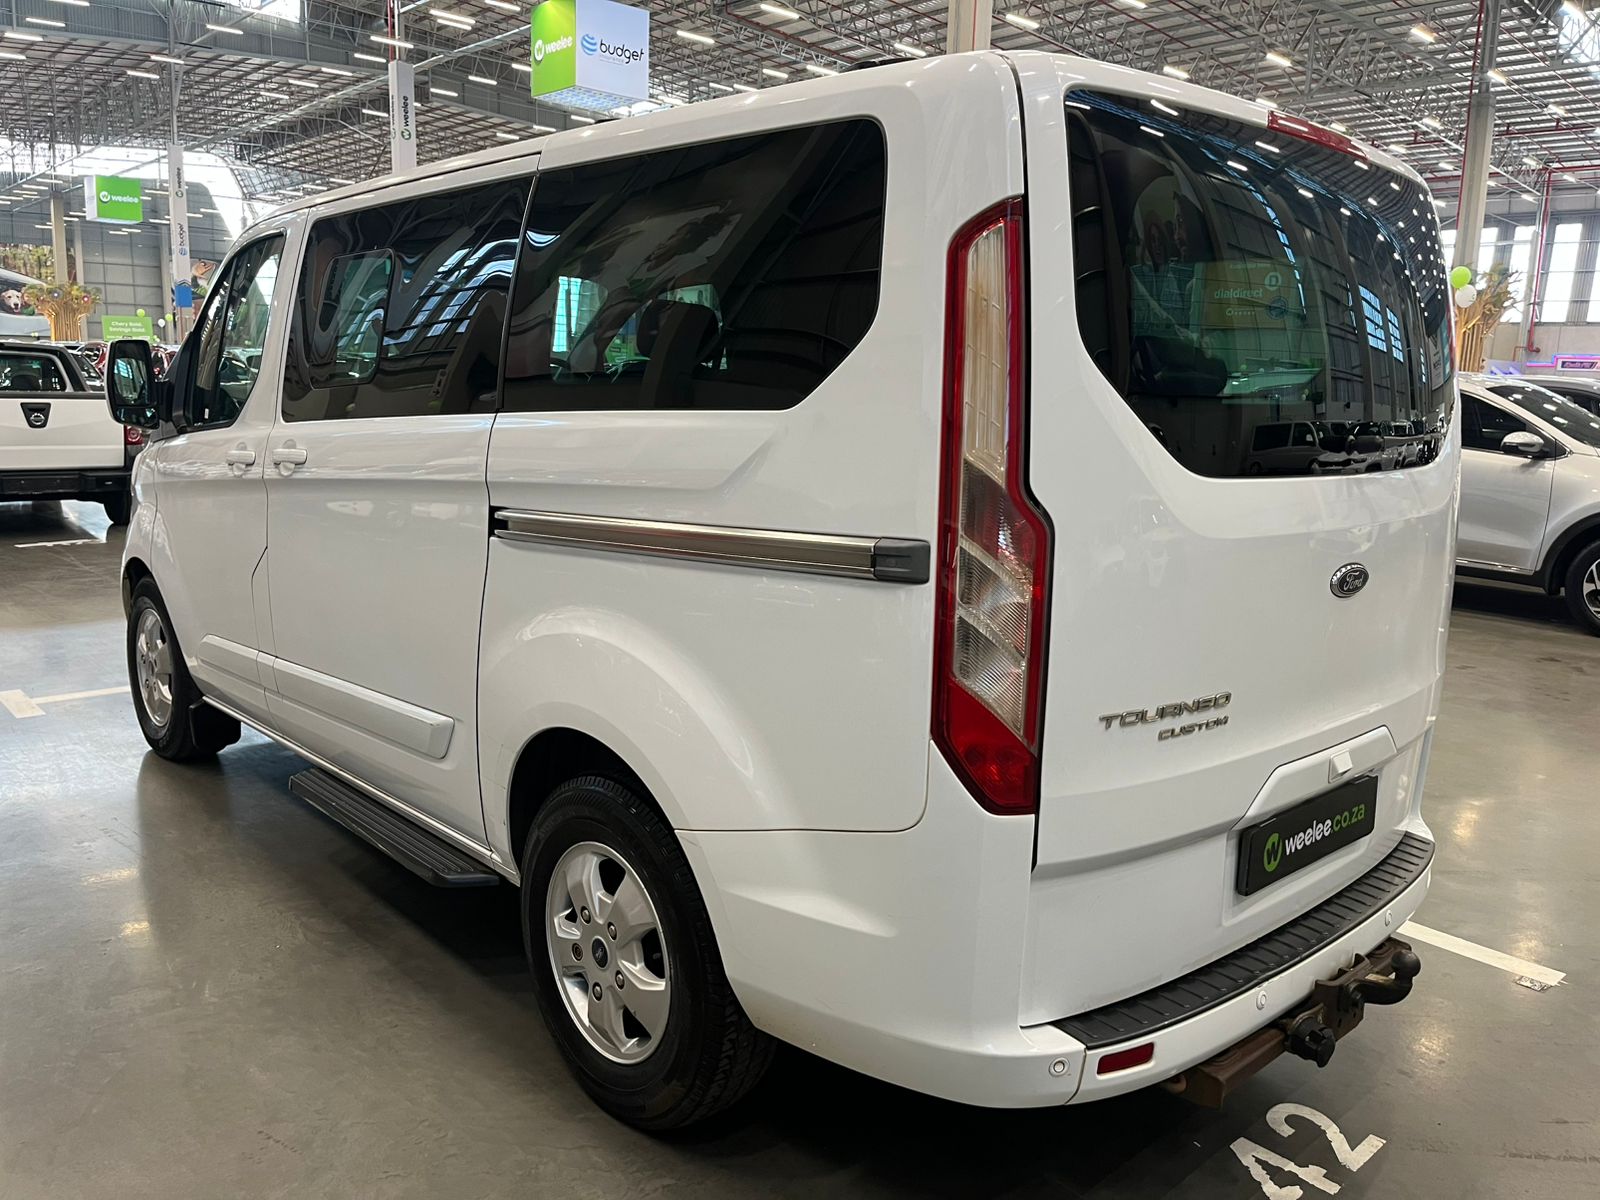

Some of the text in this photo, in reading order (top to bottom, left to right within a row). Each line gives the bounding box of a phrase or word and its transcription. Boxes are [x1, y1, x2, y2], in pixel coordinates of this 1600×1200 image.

[544, 36, 573, 55] weelee
[600, 39, 645, 64] budget
[402, 95, 410, 127] weelee
[111, 195, 139, 204] weelee
[1214, 287, 1264, 299] dialdirect
[1343, 571, 1365, 591] Ford
[1098, 691, 1232, 731] TOURNEO
[1158, 715, 1229, 741] CUSTOM
[1285, 803, 1365, 856] weelee.co.za
[1229, 1103, 1387, 1200] 42
